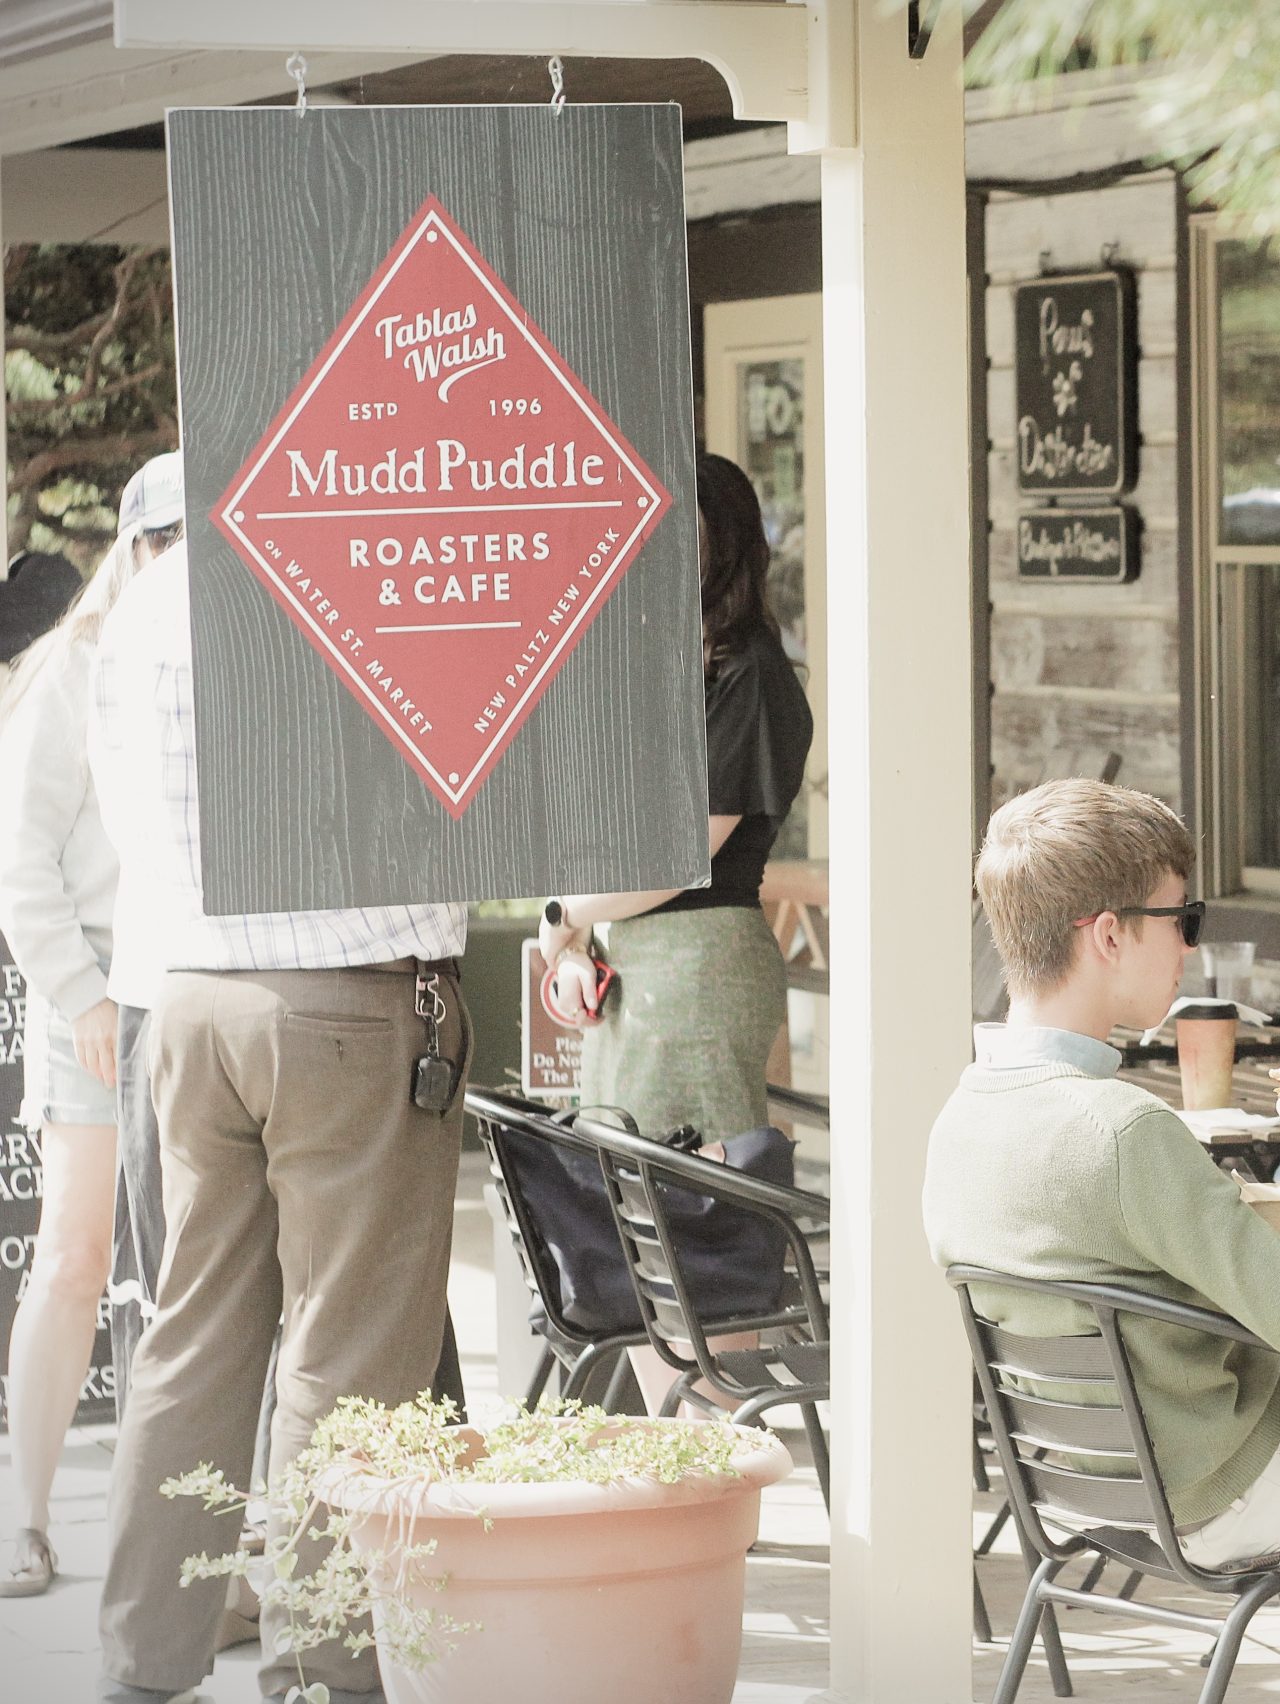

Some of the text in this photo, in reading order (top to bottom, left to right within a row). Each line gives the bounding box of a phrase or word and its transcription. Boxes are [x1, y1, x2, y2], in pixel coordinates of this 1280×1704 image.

[374, 303, 478, 359] Tablas
[403, 327, 507, 400] Walsh
[348, 398, 542, 421] ESTD 1996
[285, 439, 604, 497] Mudd Puddle
[349, 532, 550, 568] ROASTERS
[378, 572, 511, 606] & CAFE
[264, 539, 433, 735] ON WATER ST. MARKET
[473, 527, 621, 734] NEW PALTZ NEW YORK
[533, 1053, 581, 1068] Do No
[540, 1069, 568, 1085] The
